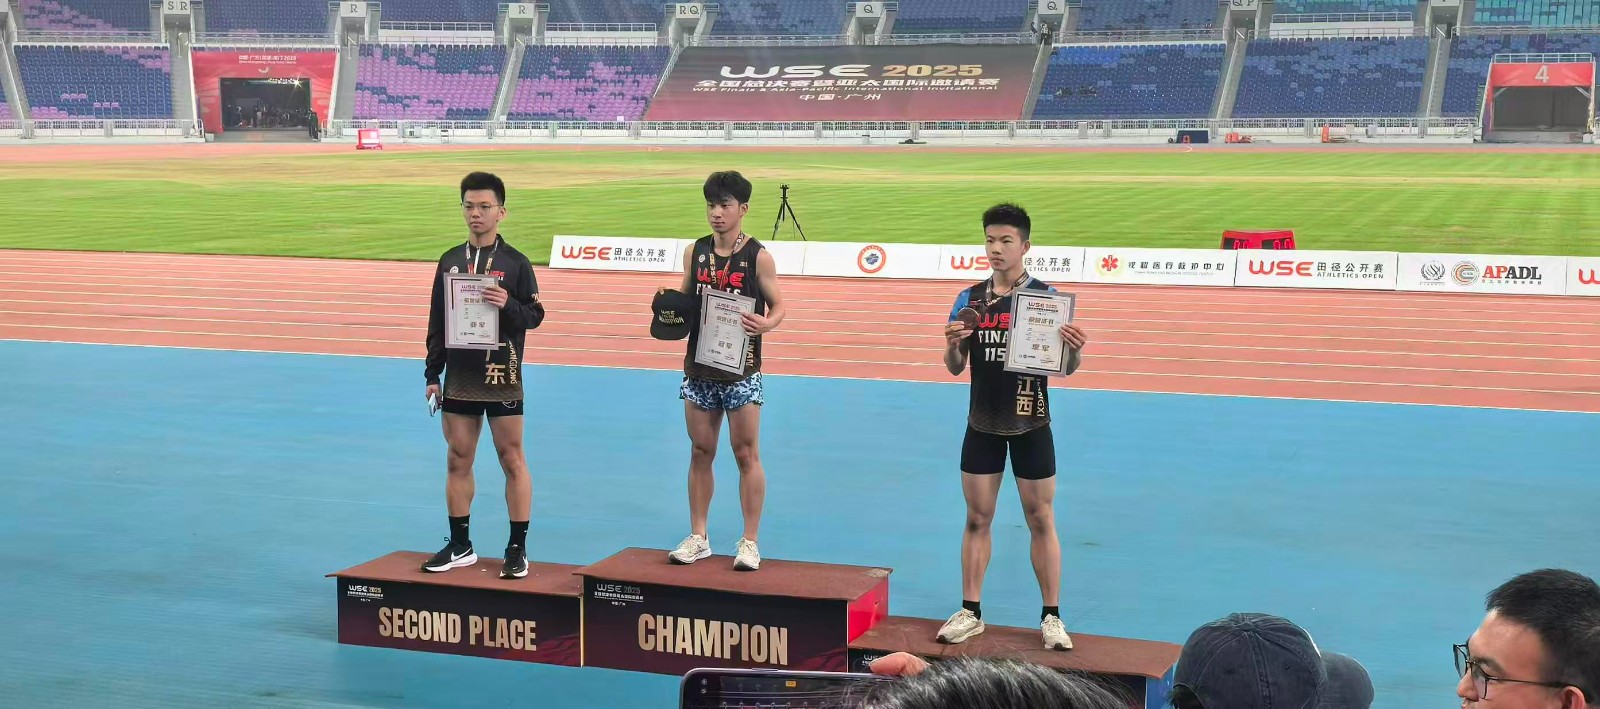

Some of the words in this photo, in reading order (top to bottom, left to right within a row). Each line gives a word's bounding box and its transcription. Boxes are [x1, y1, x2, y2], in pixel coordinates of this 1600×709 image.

[167, 1, 174, 10] S
[180, 2, 188, 10] R
[350, 4, 358, 13] R
[518, 5, 526, 14] R
[679, 5, 686, 14] R
[690, 5, 699, 14] Q
[864, 5, 873, 13] Q
[1047, 1, 1057, 10] Q
[720, 65, 871, 78] WSE
[881, 64, 983, 77] 2025
[1535, 65, 1549, 83] 4
[561, 246, 612, 260] WSE
[614, 248, 666, 258] 田径公开赛
[1249, 260, 1314, 277] WSE
[1317, 262, 1383, 273] 田径公开赛
[1482, 265, 1542, 279] APADL
[1016, 374, 1035, 416] 江西
[348, 584, 368, 592] WSE
[596, 583, 622, 593] WSE
[378, 606, 462, 644] SECOND
[469, 615, 537, 651] PLACE
[638, 613, 788, 666] CHAMPION
